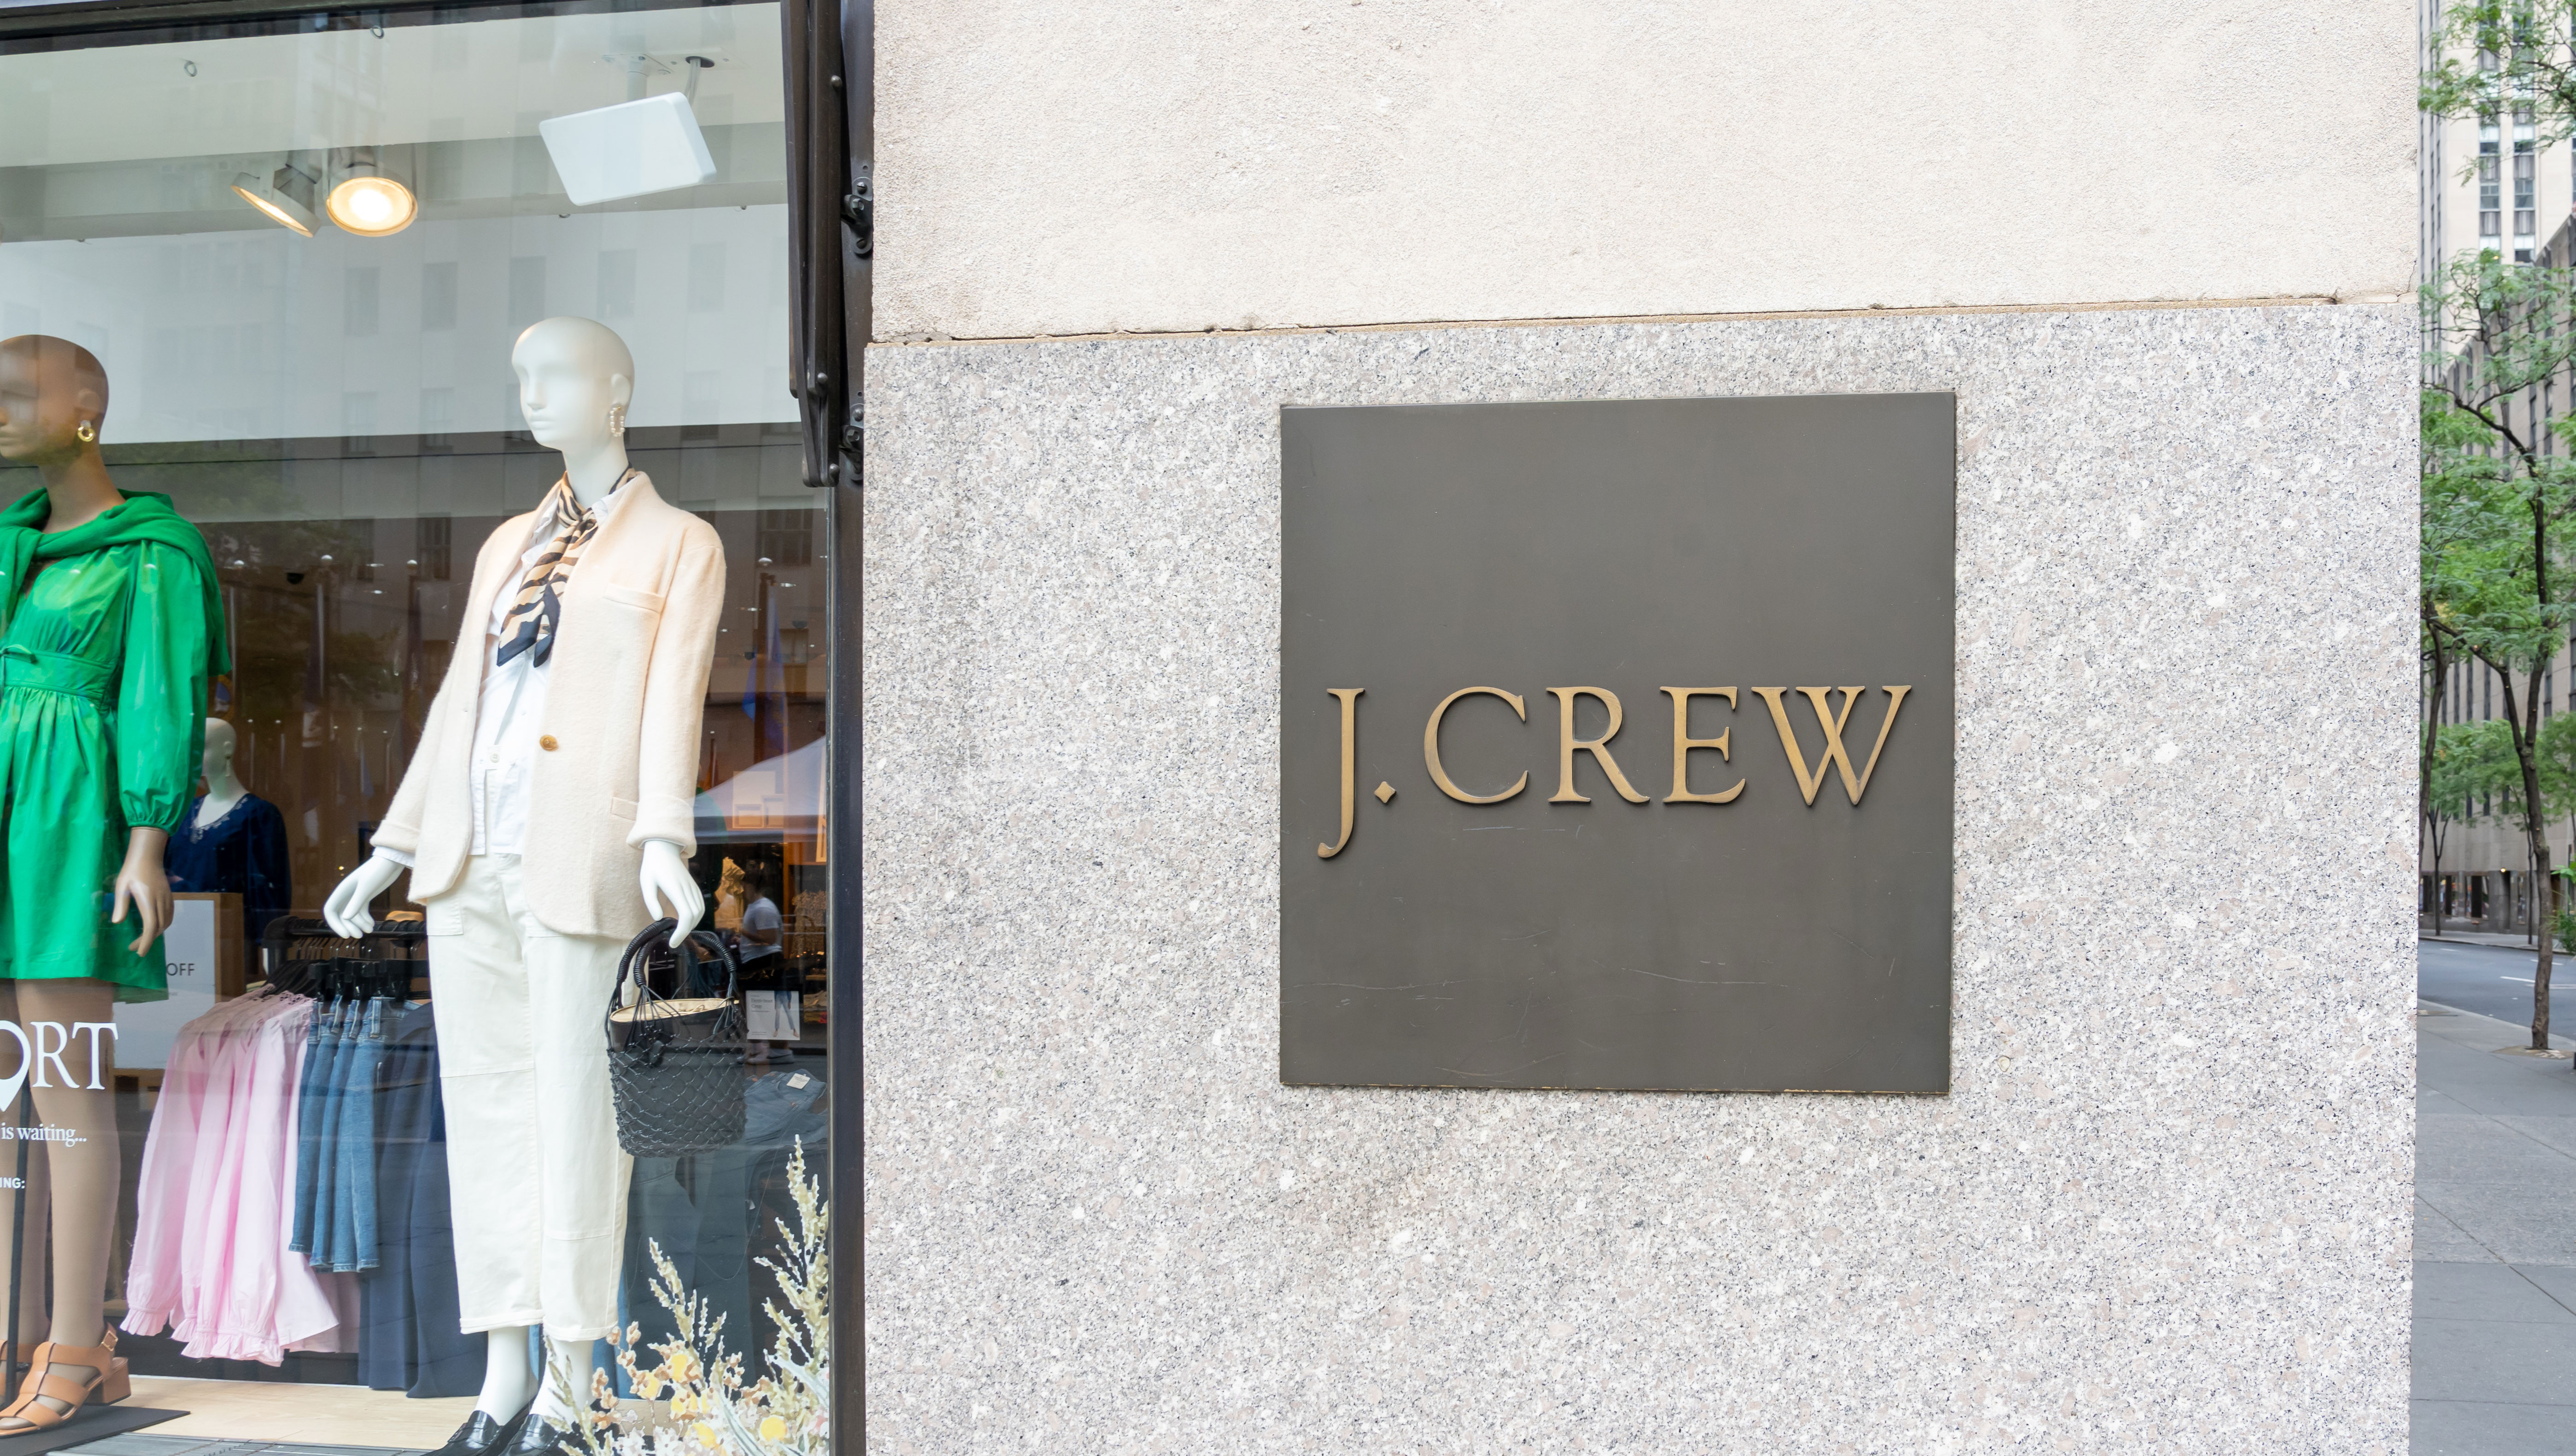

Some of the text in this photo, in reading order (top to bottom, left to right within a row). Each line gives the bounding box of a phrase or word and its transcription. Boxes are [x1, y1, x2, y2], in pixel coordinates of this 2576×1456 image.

[166, 963, 195, 976] OFF
[1, 1122, 88, 1147] is waiting...
